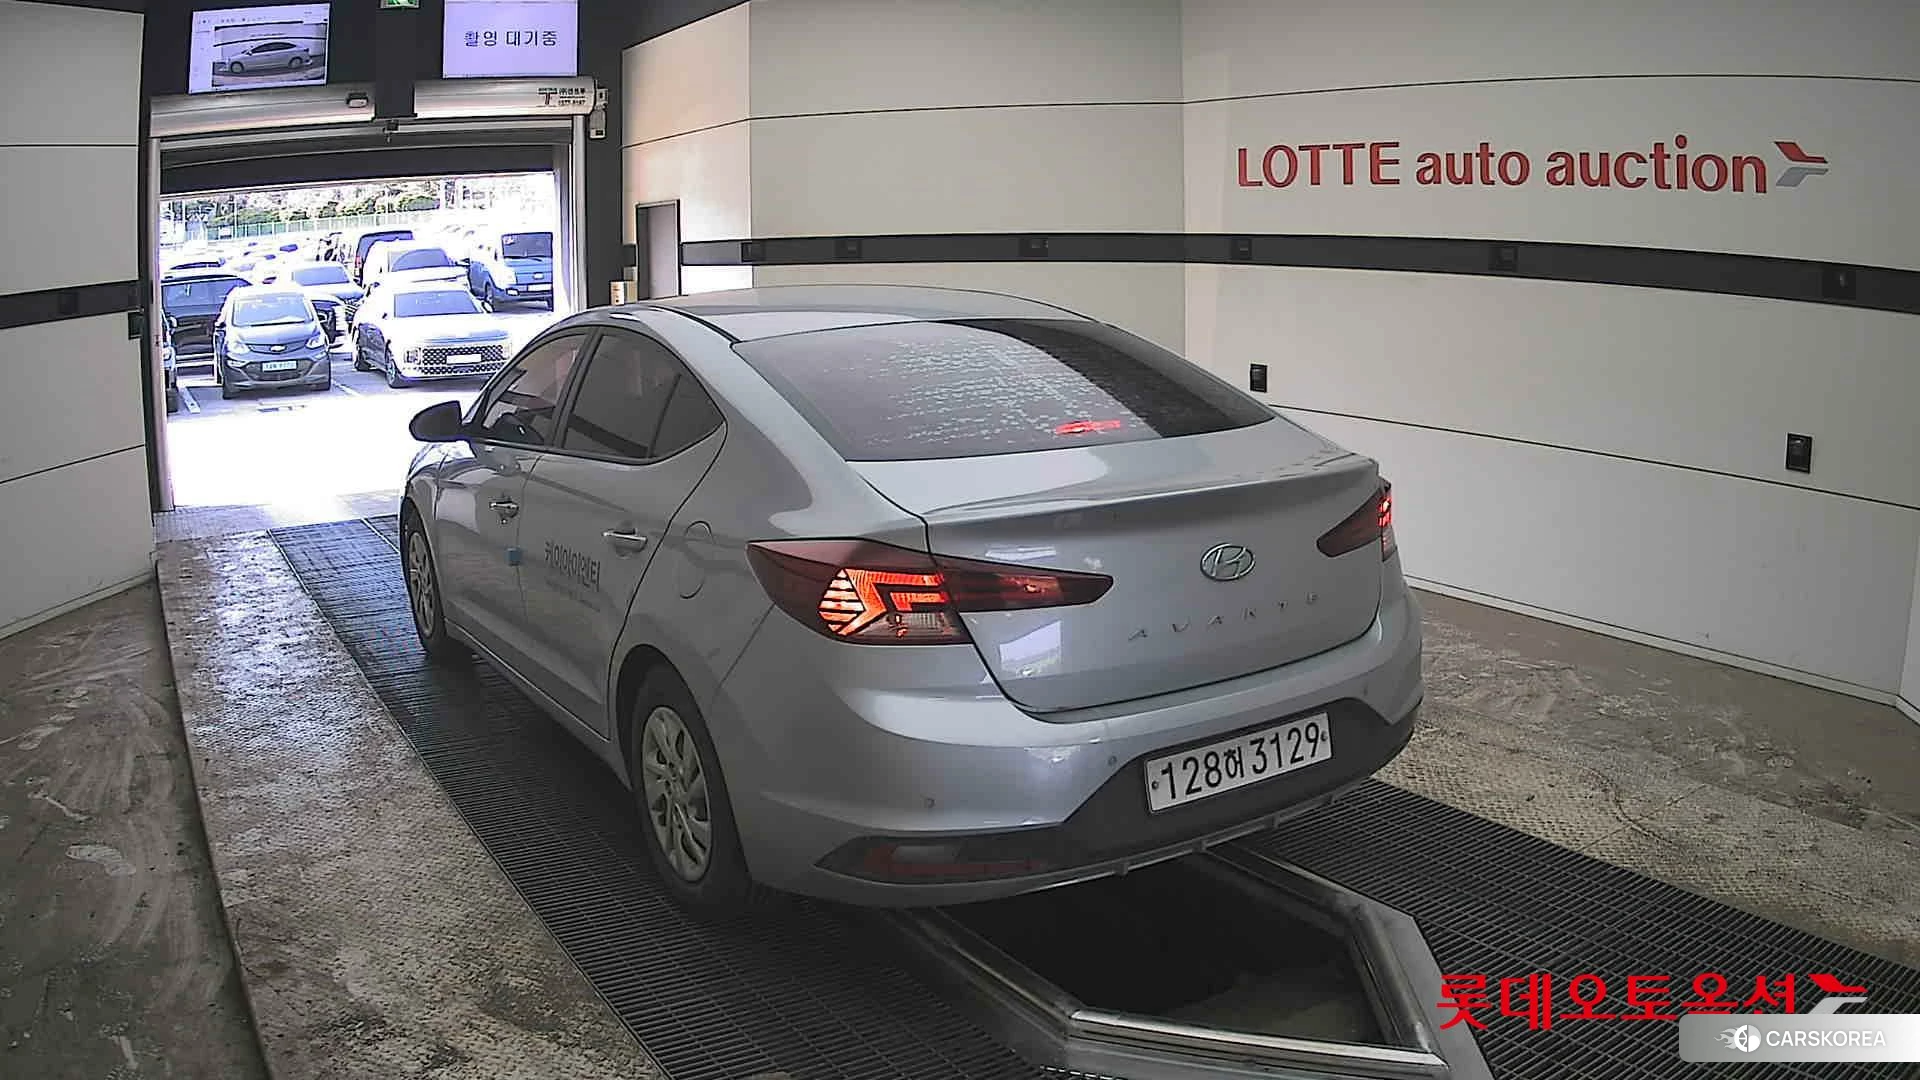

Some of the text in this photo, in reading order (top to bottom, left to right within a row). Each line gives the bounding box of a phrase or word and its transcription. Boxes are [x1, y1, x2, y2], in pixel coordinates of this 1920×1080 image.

[505, 30, 558, 47] 대기중
[1237, 134, 1767, 194] LOTTE auto auction
